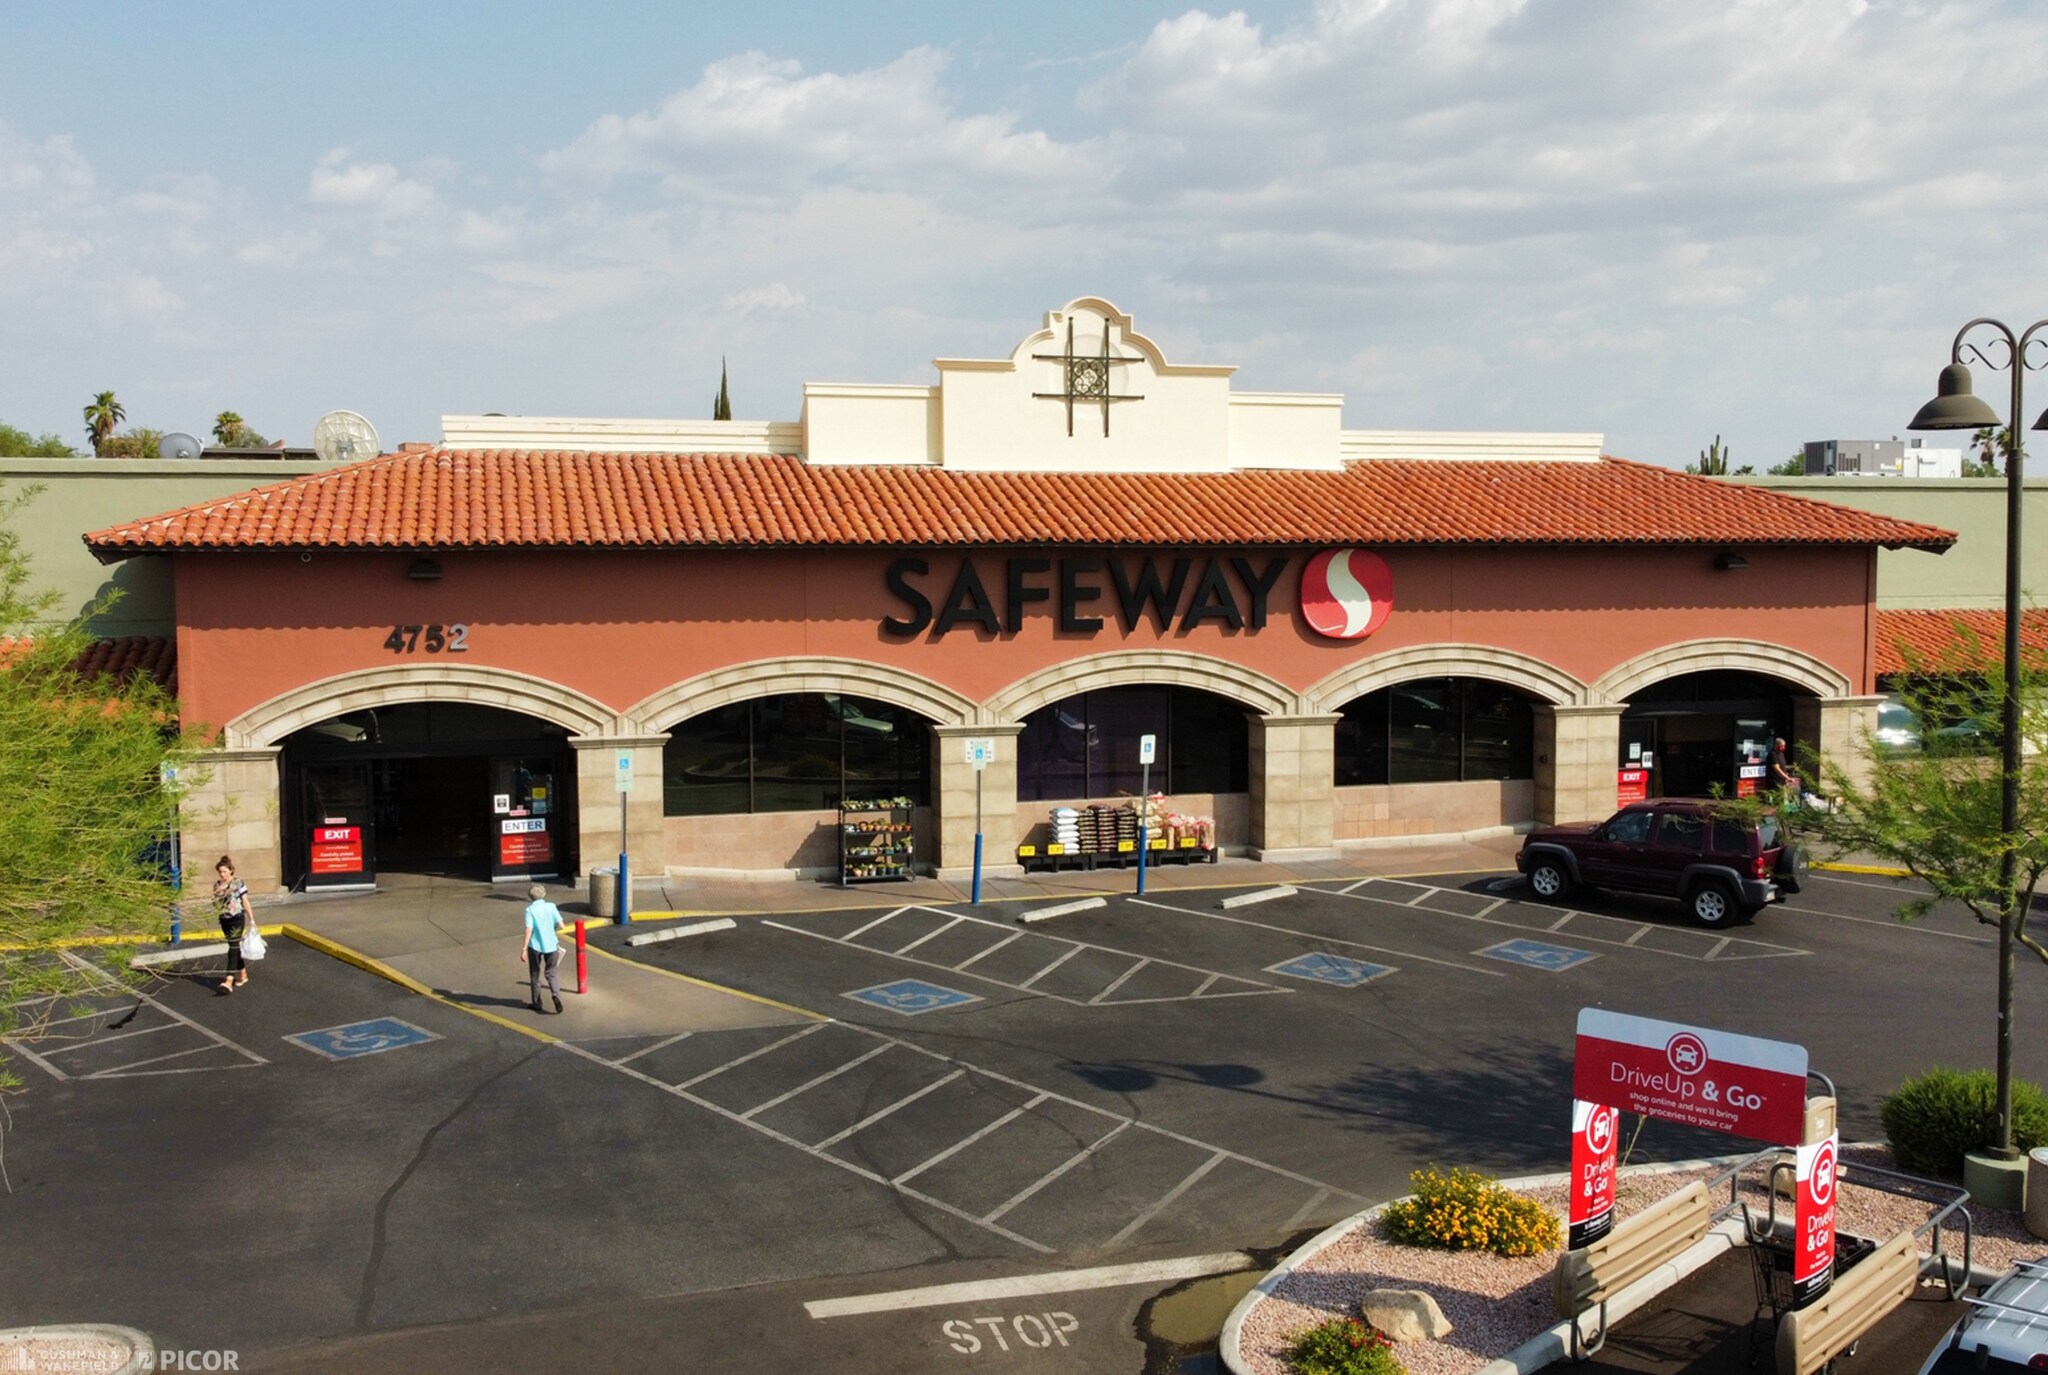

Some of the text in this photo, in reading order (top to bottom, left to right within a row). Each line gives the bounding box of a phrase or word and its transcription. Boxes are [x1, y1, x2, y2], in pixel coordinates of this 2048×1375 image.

[884, 557, 1290, 636] SAFEWAY
[384, 624, 469, 654] 4752
[1623, 772, 1641, 782] EXIT
[1742, 767, 1766, 777] ENTE
[325, 829, 351, 840] EXIT
[504, 820, 543, 832] ENTER
[1610, 1061, 1695, 1100] DriveUp
[1701, 1080, 1719, 1102] &
[1629, 1092, 1739, 1122] shop online and we'll bring
[1633, 1103, 1734, 1130] the groceries to your car
[1583, 1181, 1593, 1197] &
[1807, 1234, 1815, 1252] &
[942, 1311, 1080, 1354] STOP
